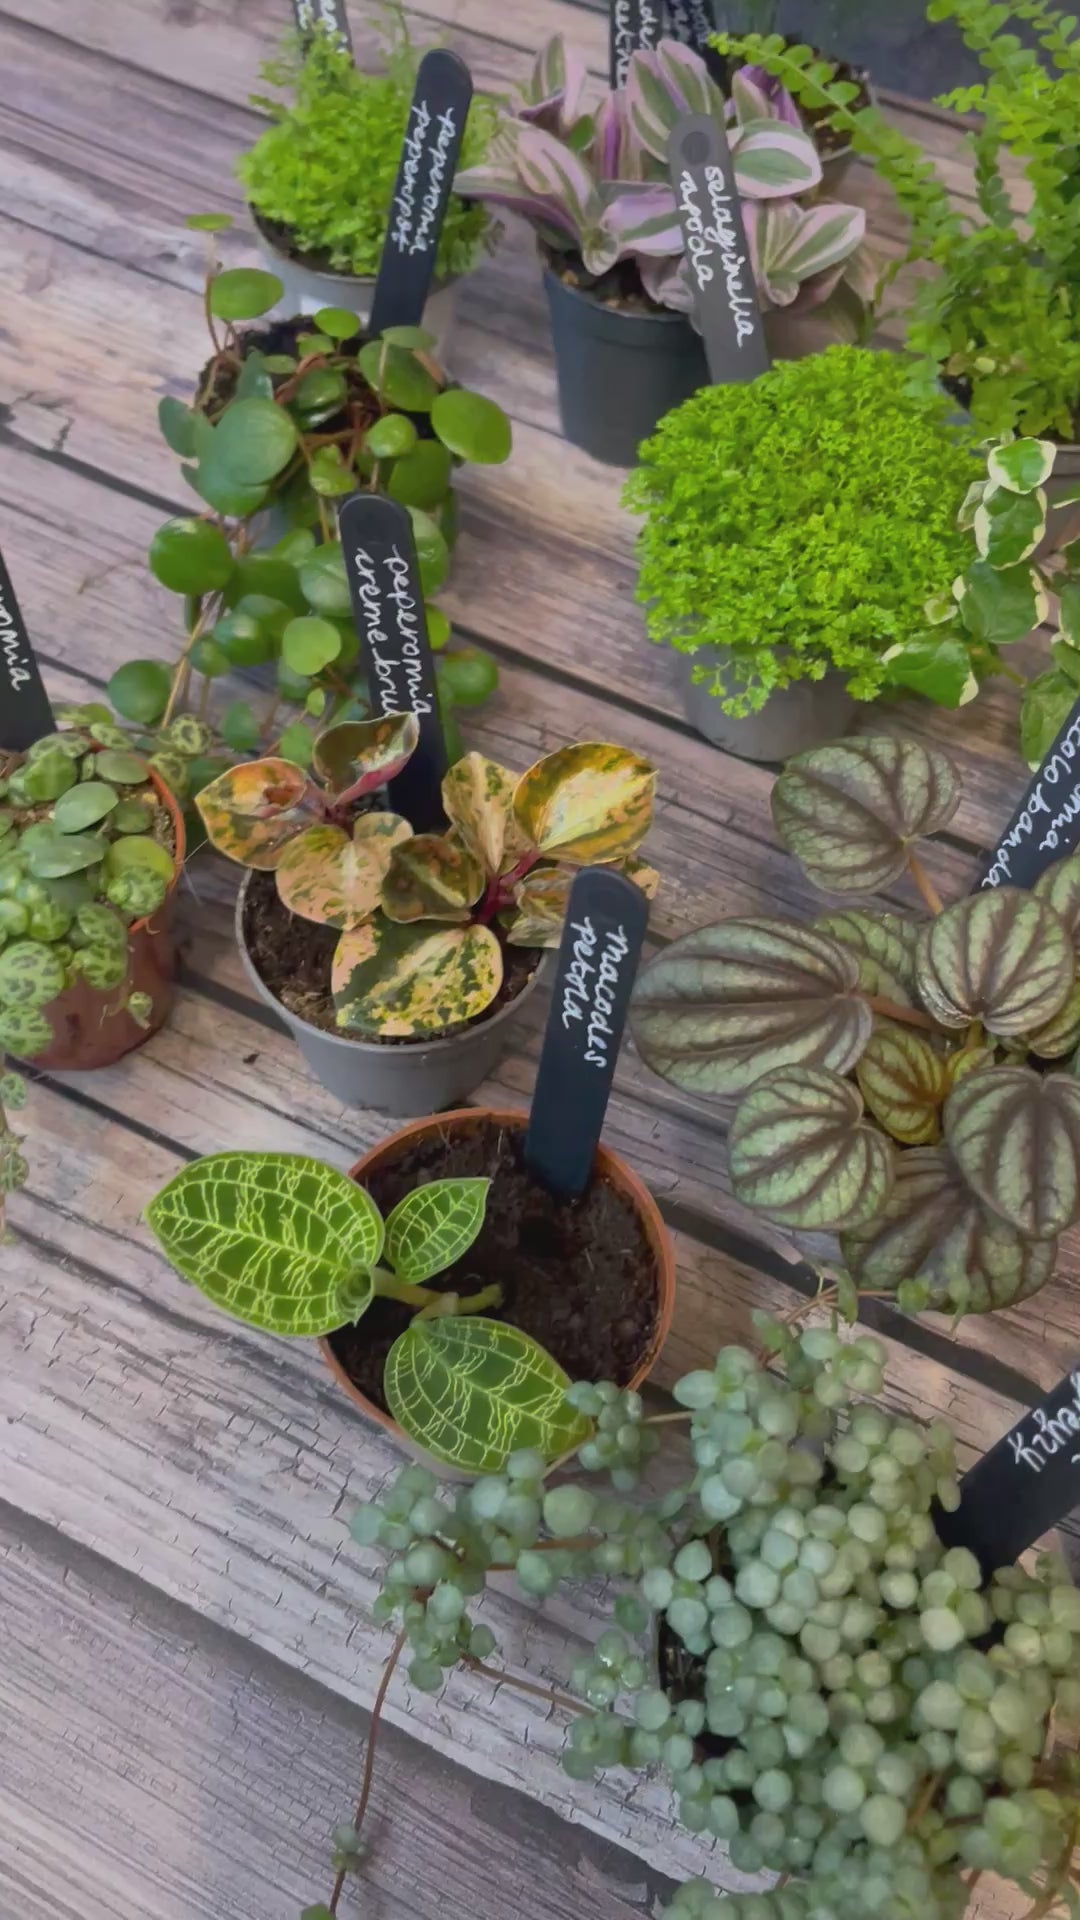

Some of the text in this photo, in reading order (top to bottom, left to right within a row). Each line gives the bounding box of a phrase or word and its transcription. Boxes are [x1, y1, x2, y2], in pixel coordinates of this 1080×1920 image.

[408, 107, 456, 256] peperomia
[679, 170, 714, 293] apoda
[704, 166, 755, 348] selaginella
[382, 543, 433, 714] peperomia
[981, 783, 1052, 889] banda
[562, 916, 598, 1029] petola
[583, 924, 630, 1069] macodes
